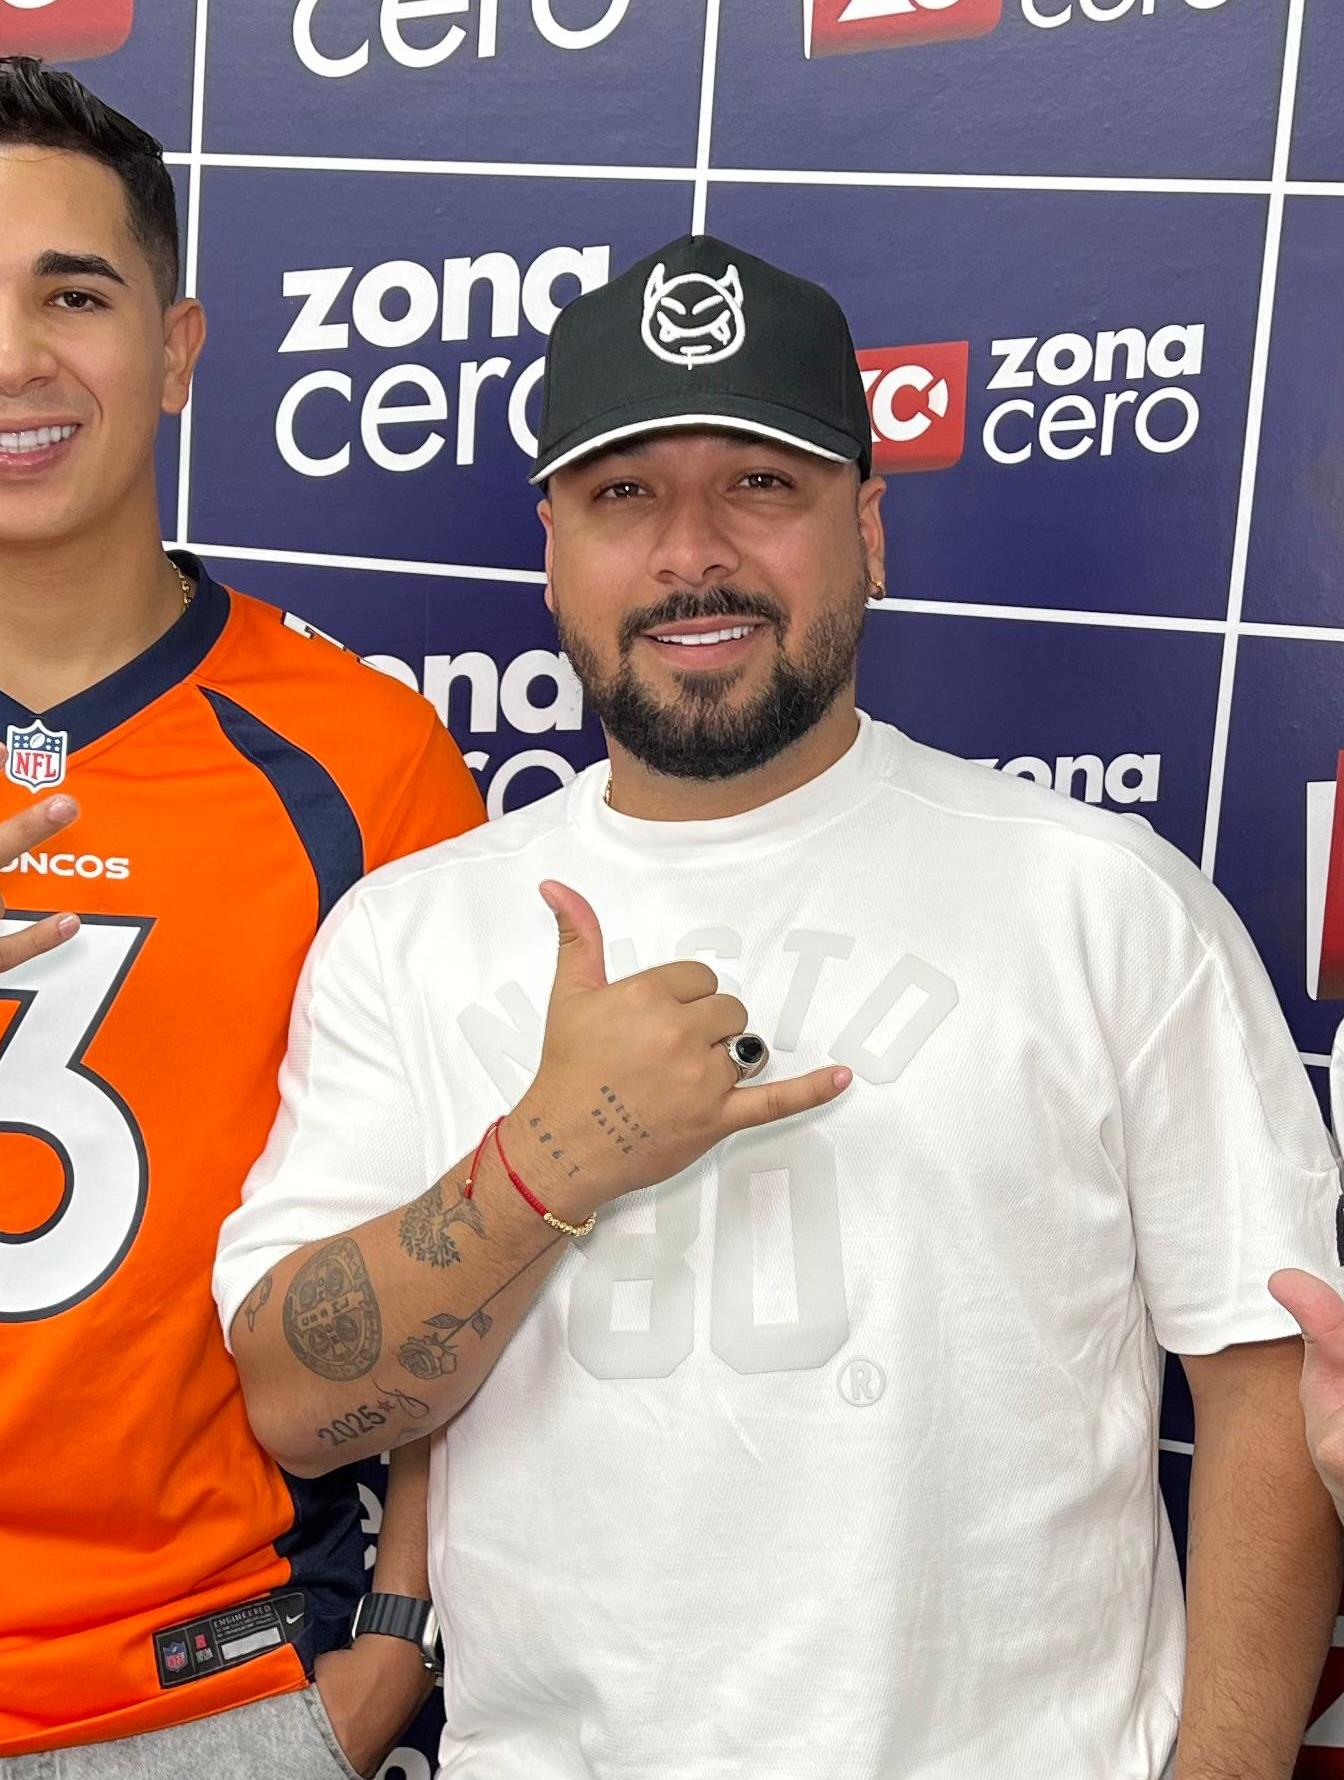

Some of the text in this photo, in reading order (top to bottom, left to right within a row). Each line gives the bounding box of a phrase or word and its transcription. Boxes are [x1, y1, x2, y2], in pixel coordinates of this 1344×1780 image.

[277, 245, 610, 353] zona
[986, 323, 1205, 390] zona
[982, 386, 1200, 464] cero
[361, 649, 584, 734] na
[15, 751, 57, 780] NFL
[966, 753, 1162, 804] na
[456, 926, 959, 1111] NTO
[568, 1128, 851, 1380] 80
[318, 1404, 386, 1446] 2025
